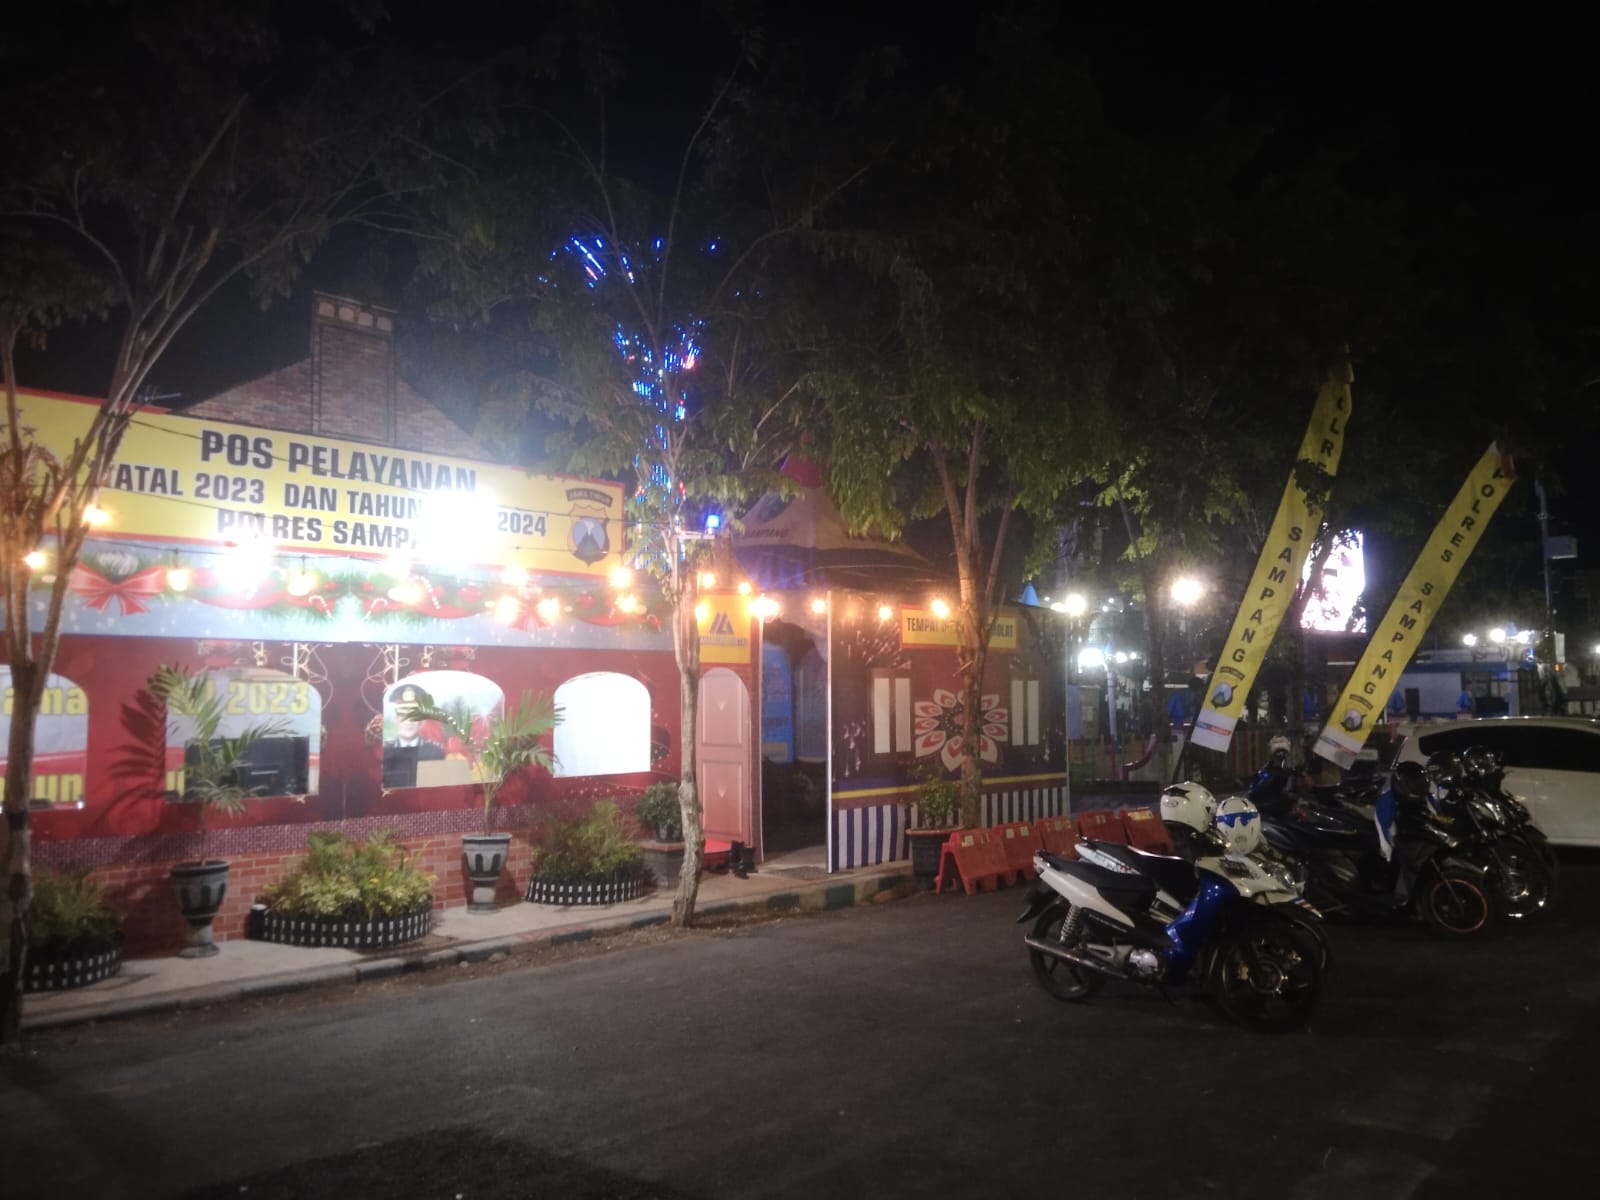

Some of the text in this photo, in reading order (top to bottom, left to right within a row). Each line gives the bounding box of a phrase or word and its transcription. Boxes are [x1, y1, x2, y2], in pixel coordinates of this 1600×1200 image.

[200, 429, 478, 493] POS PELAYANAN
[108, 463, 184, 497] ATAL
[194, 472, 265, 505] 2023
[284, 484, 337, 512] DAN
[497, 511, 547, 537] 2024
[1231, 525, 1304, 663] SAMPANG
[1363, 581, 1434, 695] SAMPANG
[227, 680, 309, 715] 2023
